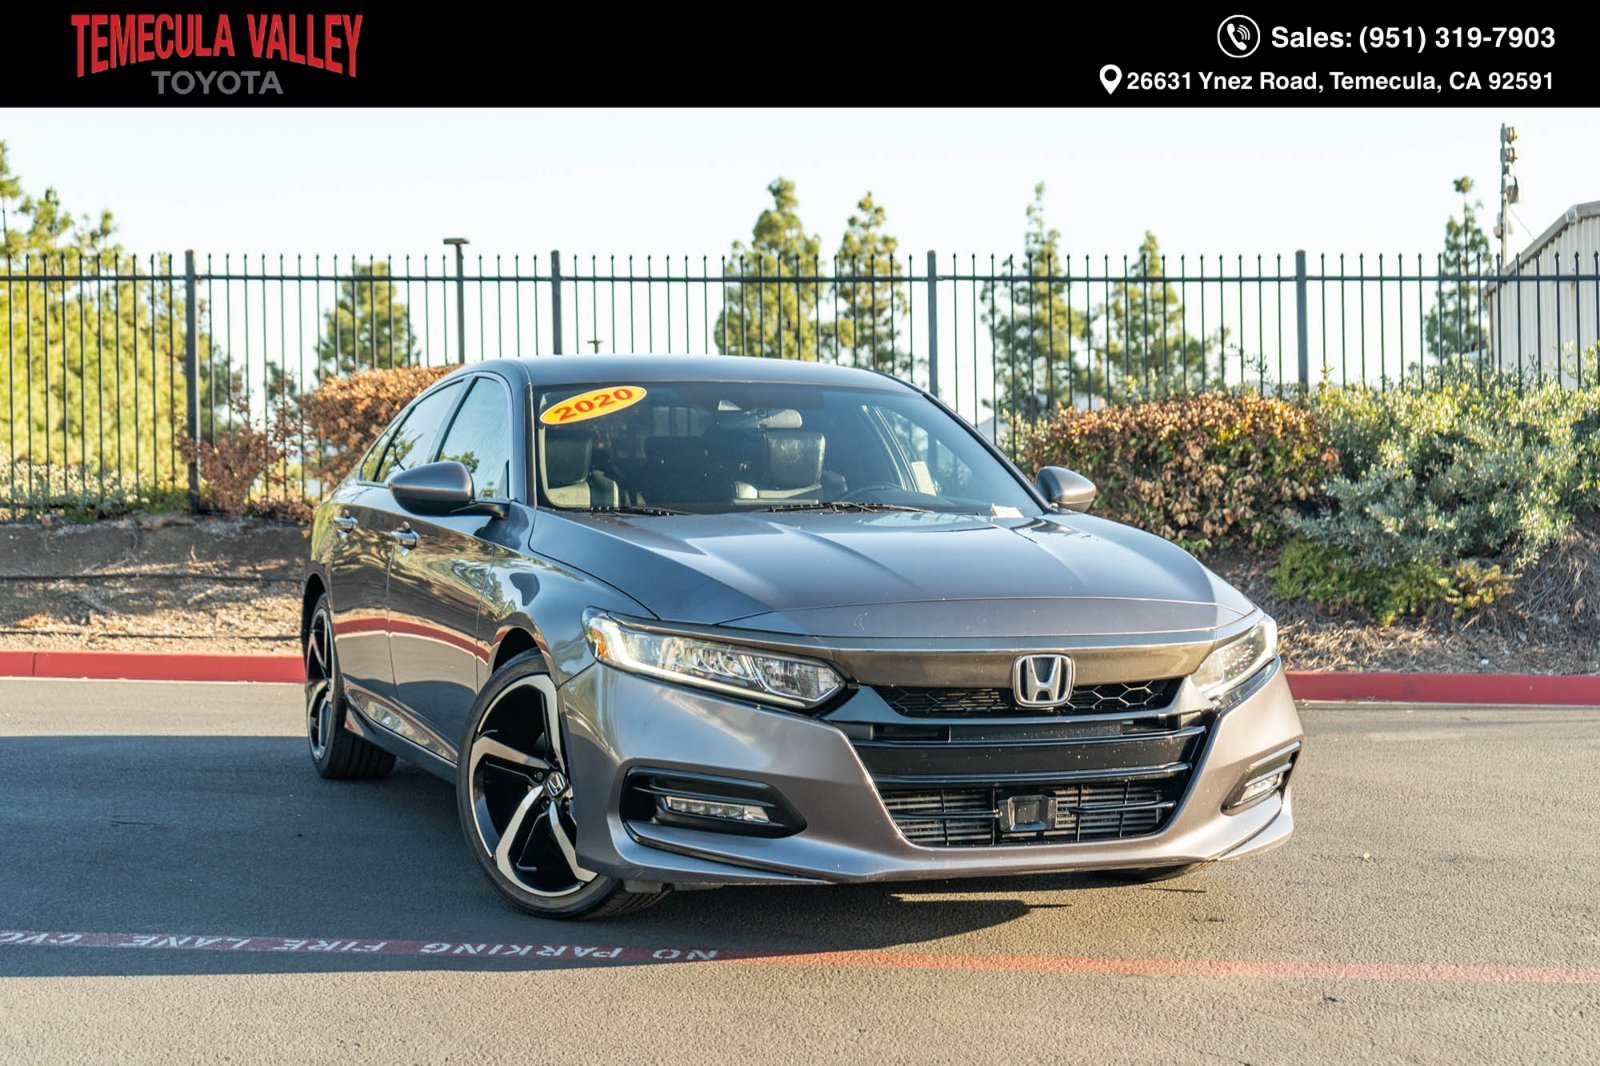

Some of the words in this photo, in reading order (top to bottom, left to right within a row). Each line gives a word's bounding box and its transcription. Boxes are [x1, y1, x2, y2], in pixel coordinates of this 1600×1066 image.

[554, 388, 633, 422] 2020
[120, 935, 250, 950] LANE
[273, 939, 388, 952] FIRE
[420, 942, 623, 958] PARKING
[652, 949, 718, 961] NO
